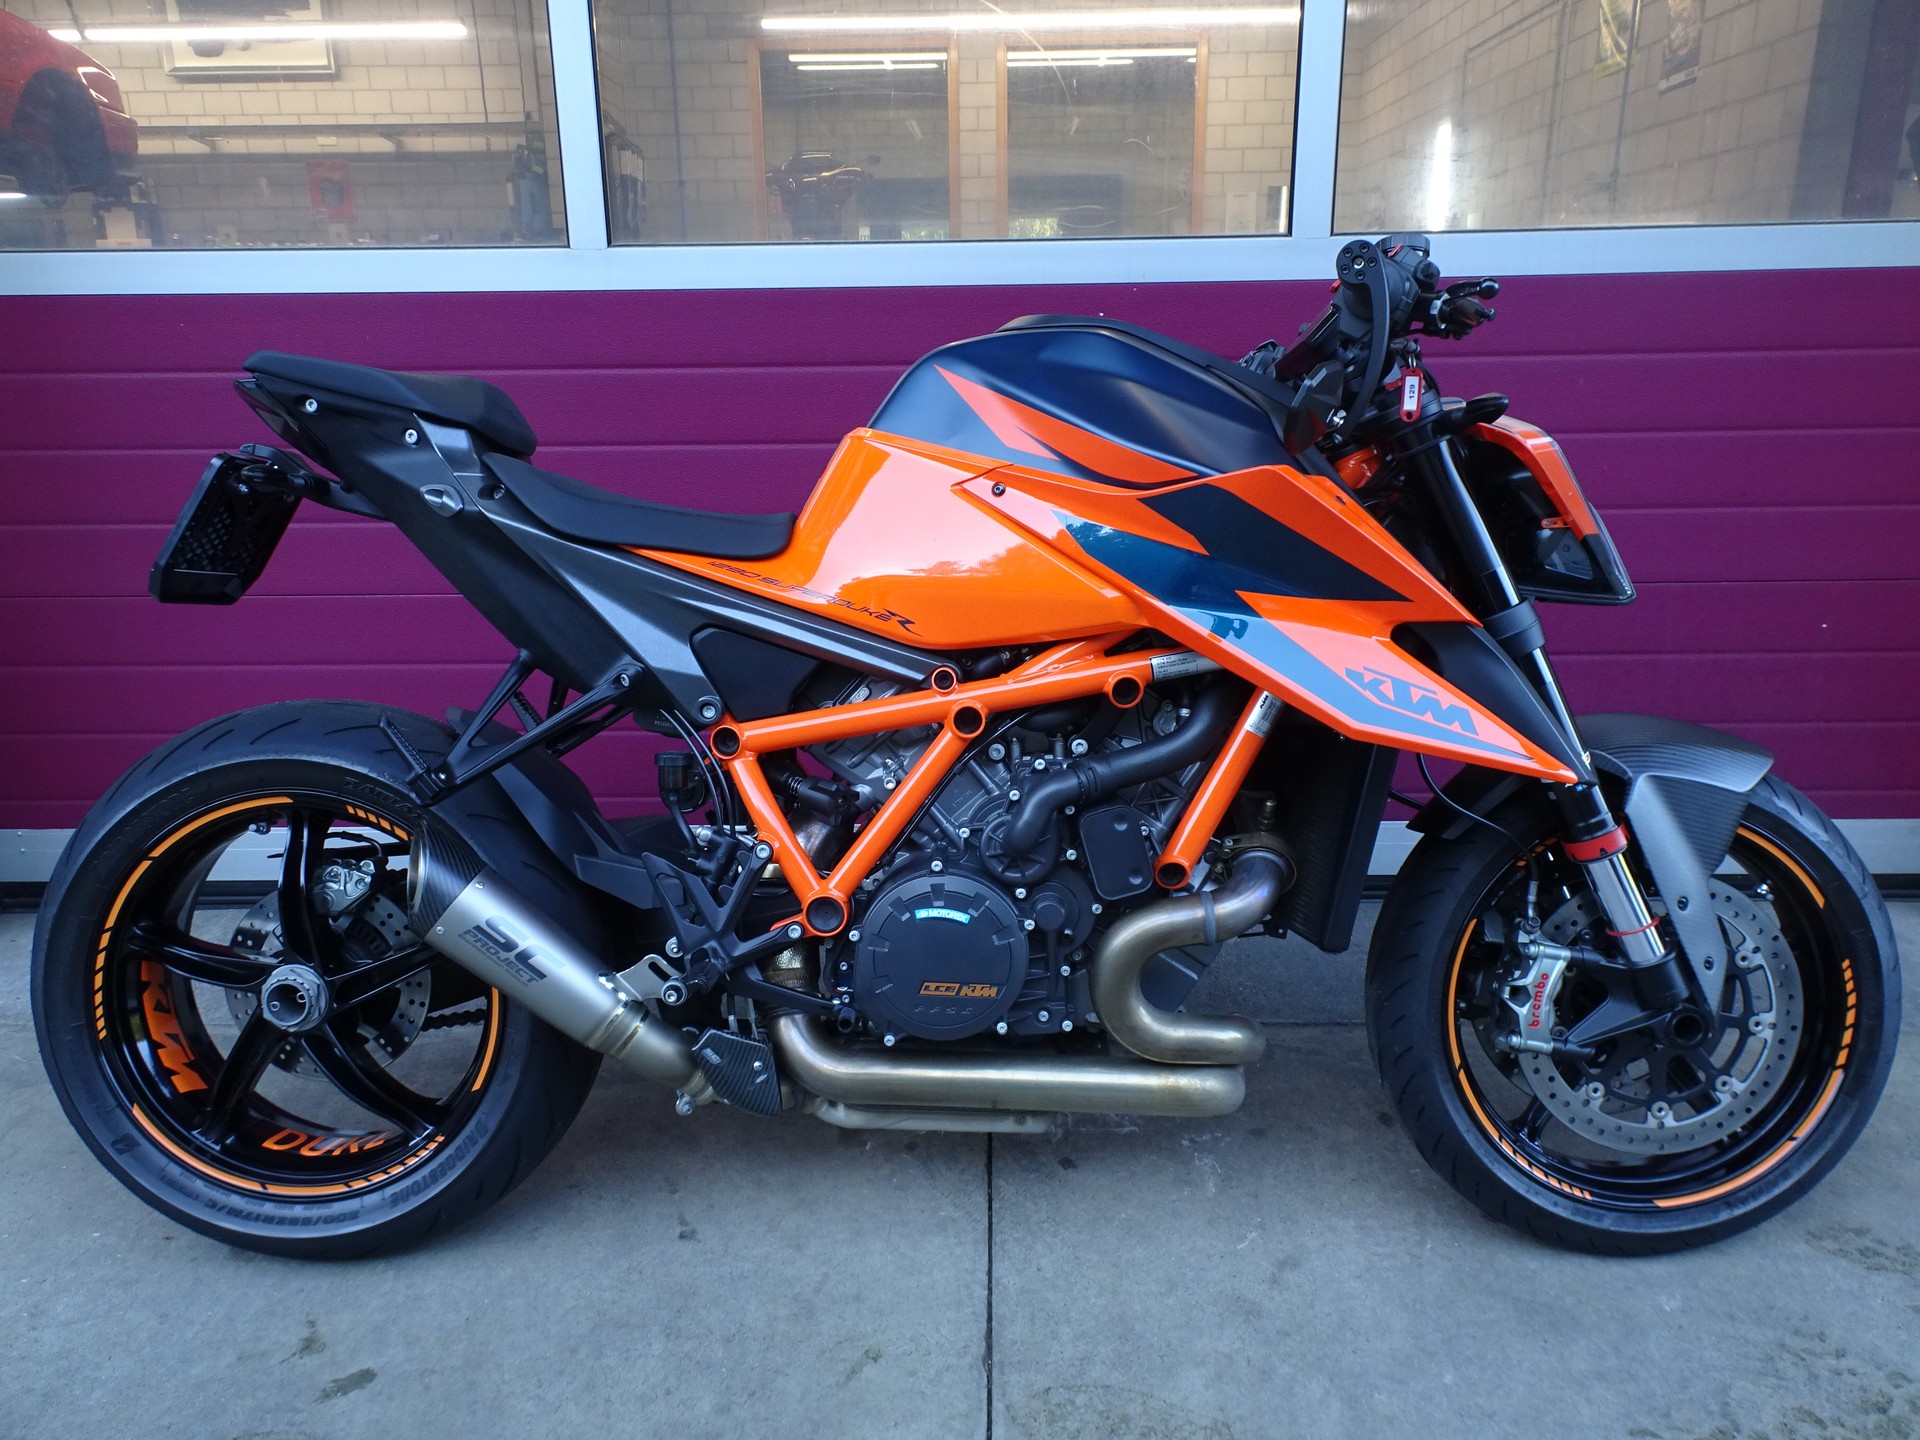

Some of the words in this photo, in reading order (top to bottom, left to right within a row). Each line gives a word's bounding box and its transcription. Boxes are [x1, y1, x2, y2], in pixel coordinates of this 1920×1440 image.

[1408, 384, 1416, 400] 129
[883, 607, 925, 638] R
[1345, 665, 1479, 737] KTM
[929, 908, 968, 924] MOTOREX
[462, 928, 540, 984] PROJECT
[471, 914, 566, 982] SC
[959, 983, 999, 998] KTM
[1527, 972, 1550, 1029] brembo
[140, 959, 209, 1094] KTM
[261, 1127, 391, 1157] DUKE
[389, 1116, 490, 1209] BRIDGESTONE
